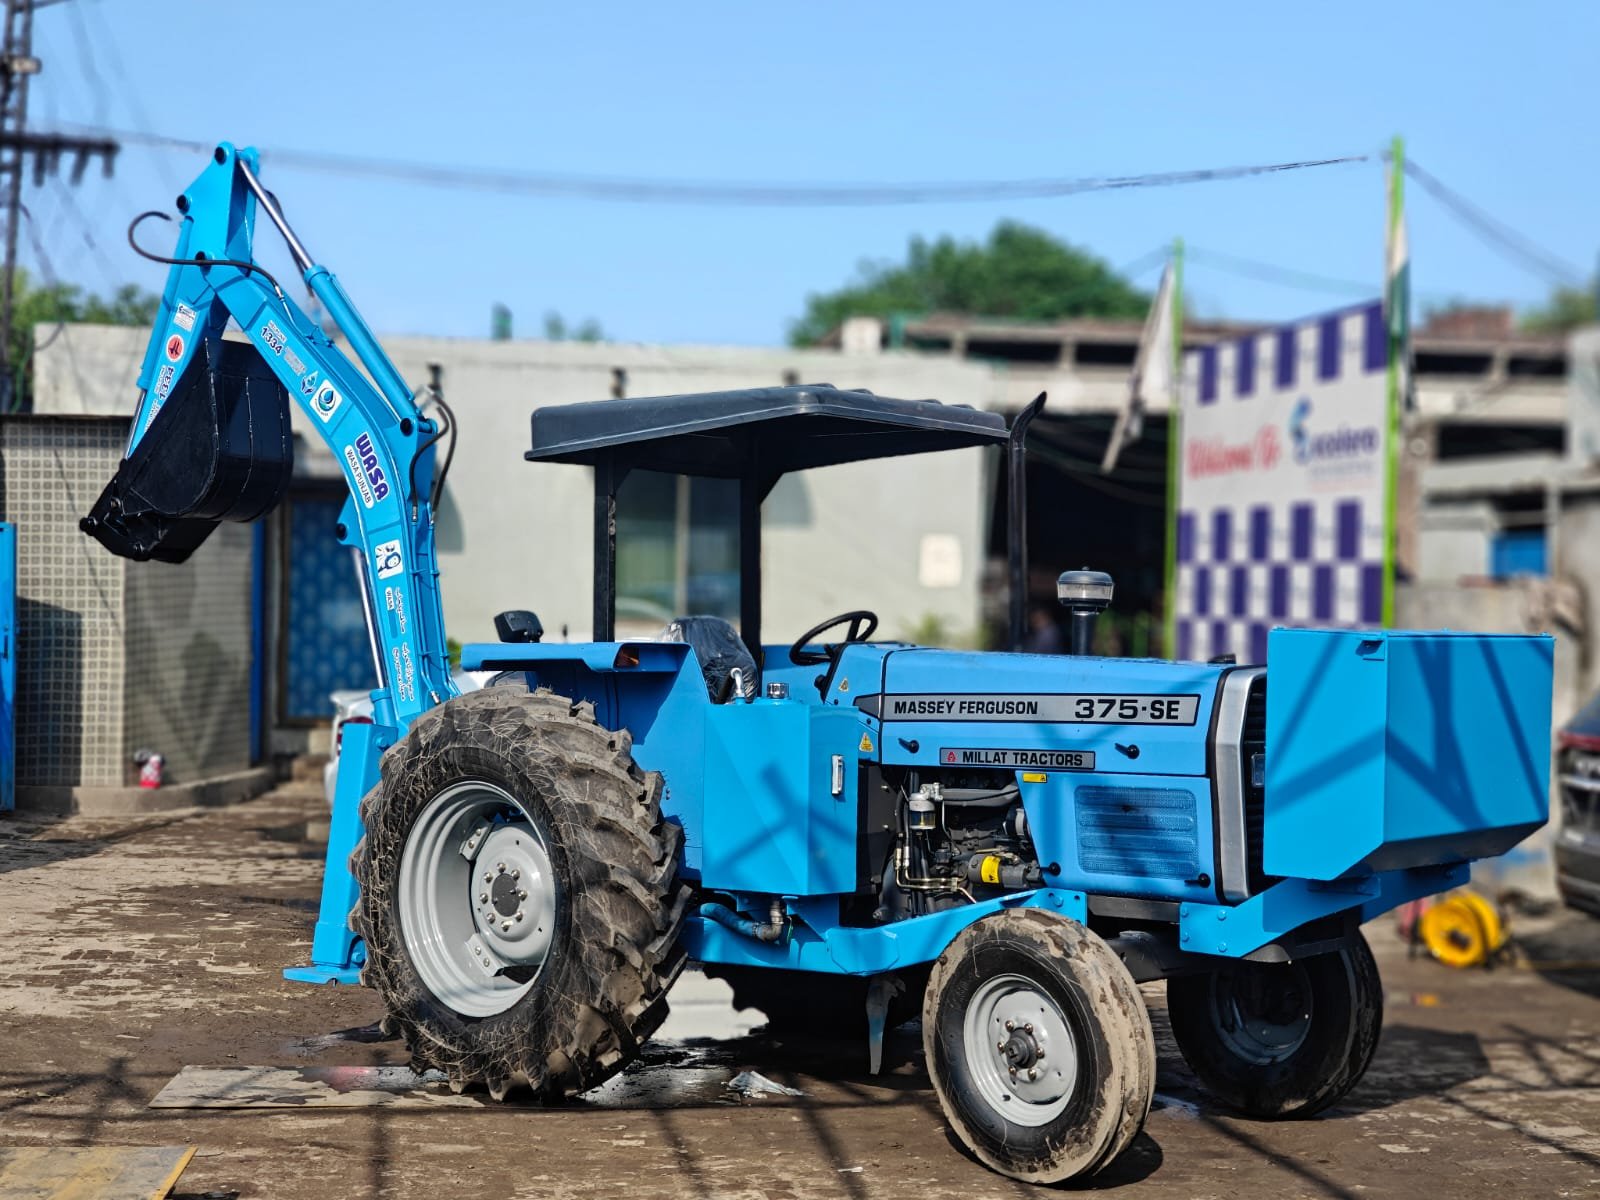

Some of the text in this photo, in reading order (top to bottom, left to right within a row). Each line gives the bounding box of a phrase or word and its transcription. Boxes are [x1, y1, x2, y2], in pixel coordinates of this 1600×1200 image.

[261, 327, 283, 355] 1334
[159, 367, 174, 399] 1334
[347, 449, 371, 503] WASA PUNJAB
[356, 433, 388, 500] WASA
[894, 701, 1038, 714] MASSEY FERGUSON
[962, 751, 1083, 766] MILLAT TRACTORS
